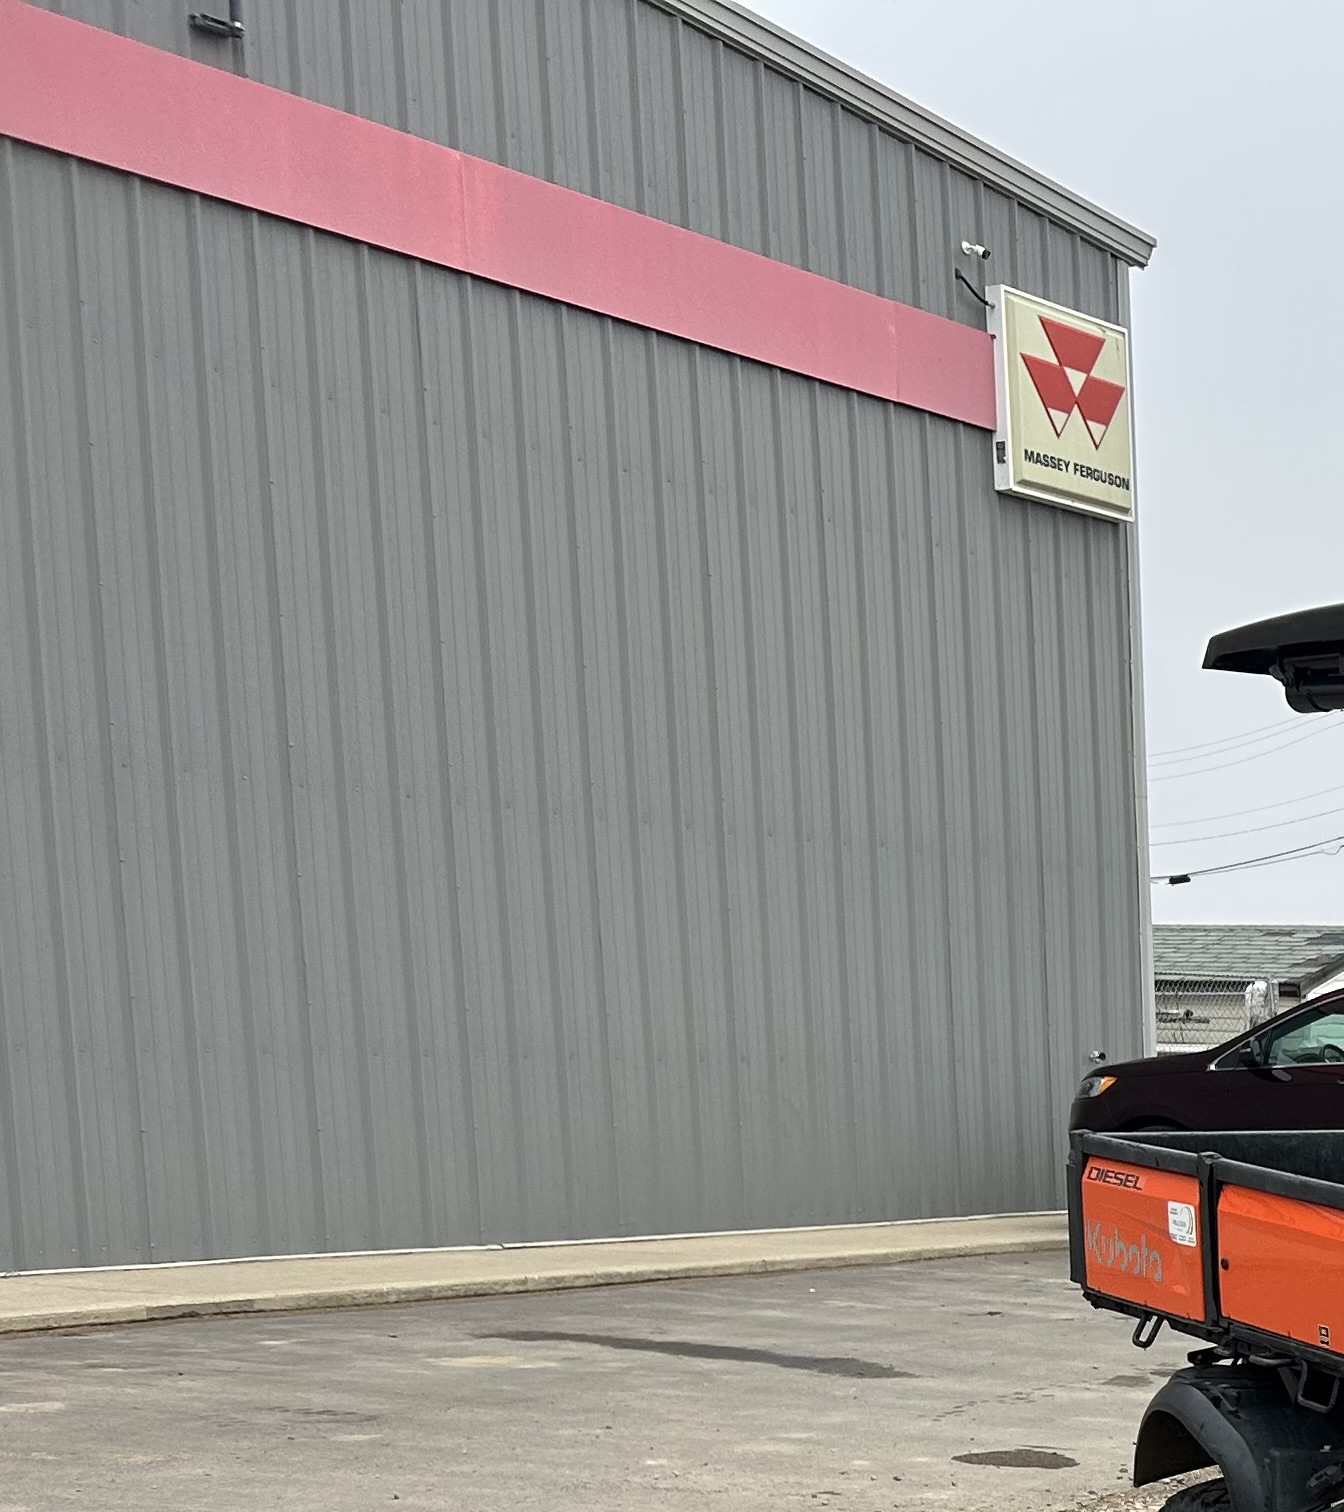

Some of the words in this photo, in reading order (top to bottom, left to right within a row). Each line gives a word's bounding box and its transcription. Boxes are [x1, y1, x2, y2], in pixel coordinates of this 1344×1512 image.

[1024, 448, 1071, 474] MASSEY
[1073, 463, 1130, 491] FERGUSON
[1086, 1166, 1143, 1191] DIESEL
[1086, 1219, 1164, 1284] Kubota
